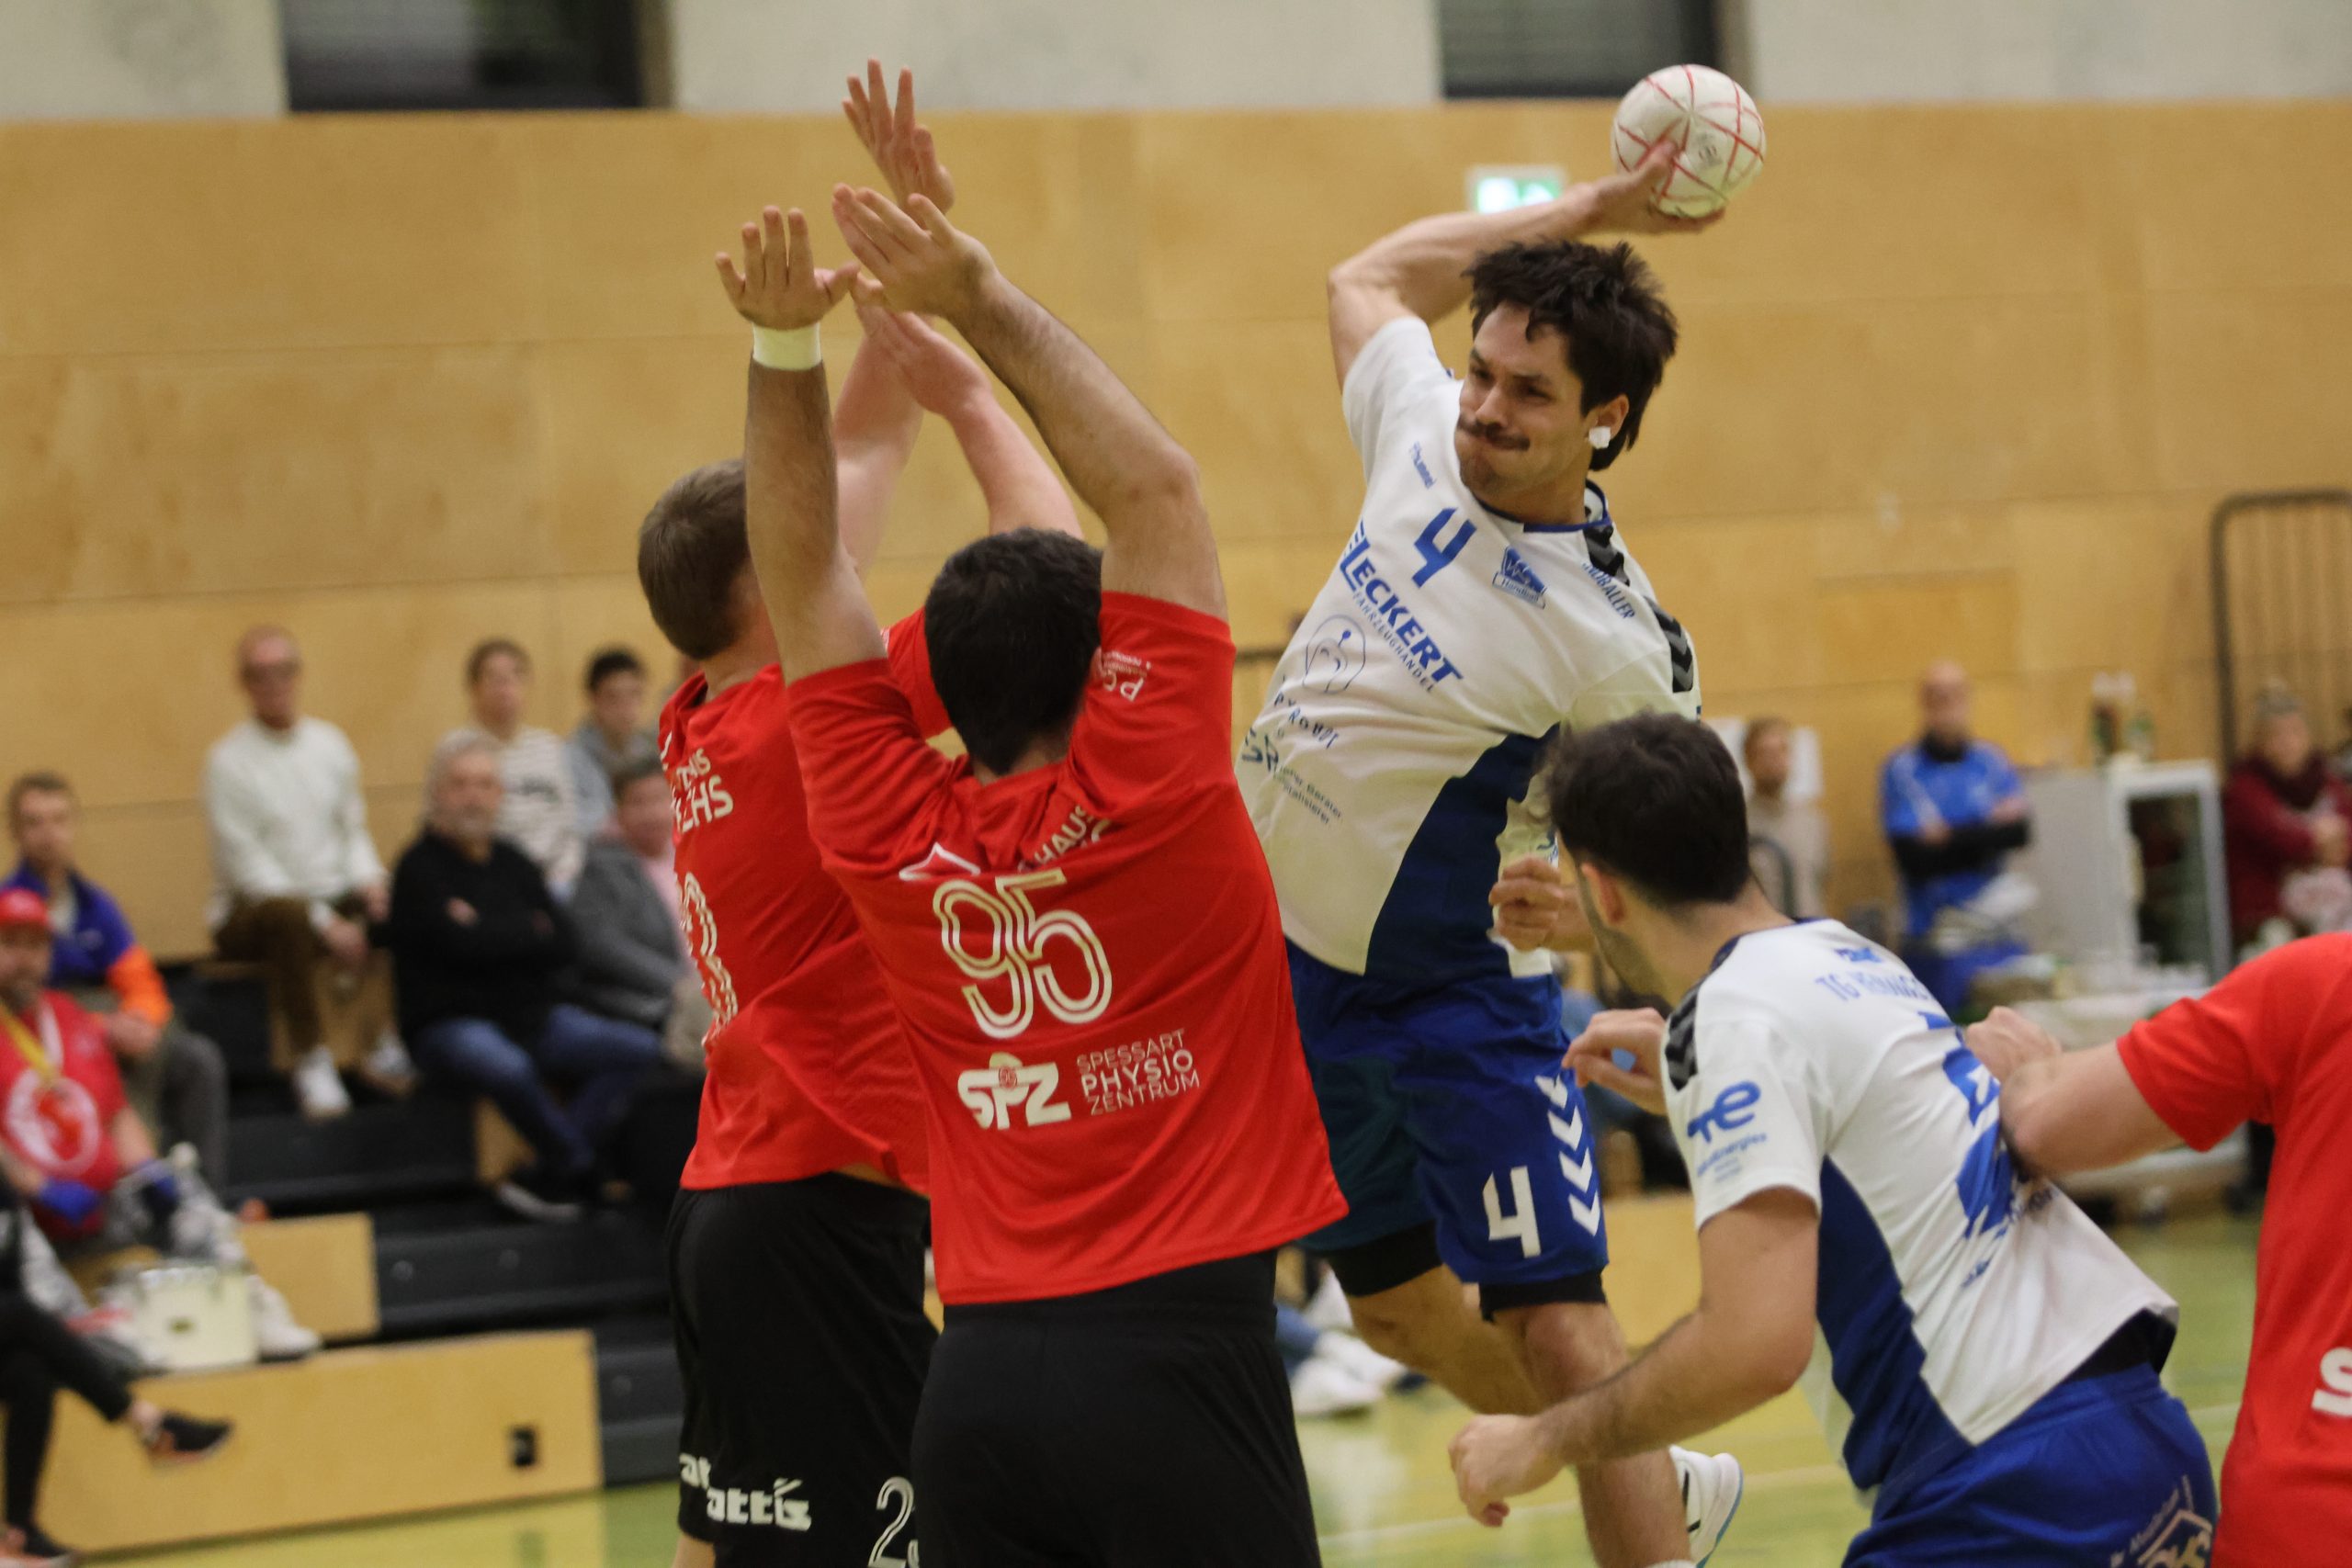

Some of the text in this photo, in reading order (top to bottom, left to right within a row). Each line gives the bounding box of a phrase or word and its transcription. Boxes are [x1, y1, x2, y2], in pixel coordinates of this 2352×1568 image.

[1412, 507, 1477, 589] 4
[1340, 536, 1464, 683] LECKERT
[1352, 591, 1436, 694] FAHRZEUGHANDEL
[933, 866, 1114, 1040] 95
[1076, 1027, 1185, 1075] SPESSART
[1080, 1048, 1193, 1098] PHYSIO
[1087, 1068, 1201, 1116] ZENTRUM
[1482, 1166, 1542, 1258] 4
[868, 1476, 919, 1568] 2
